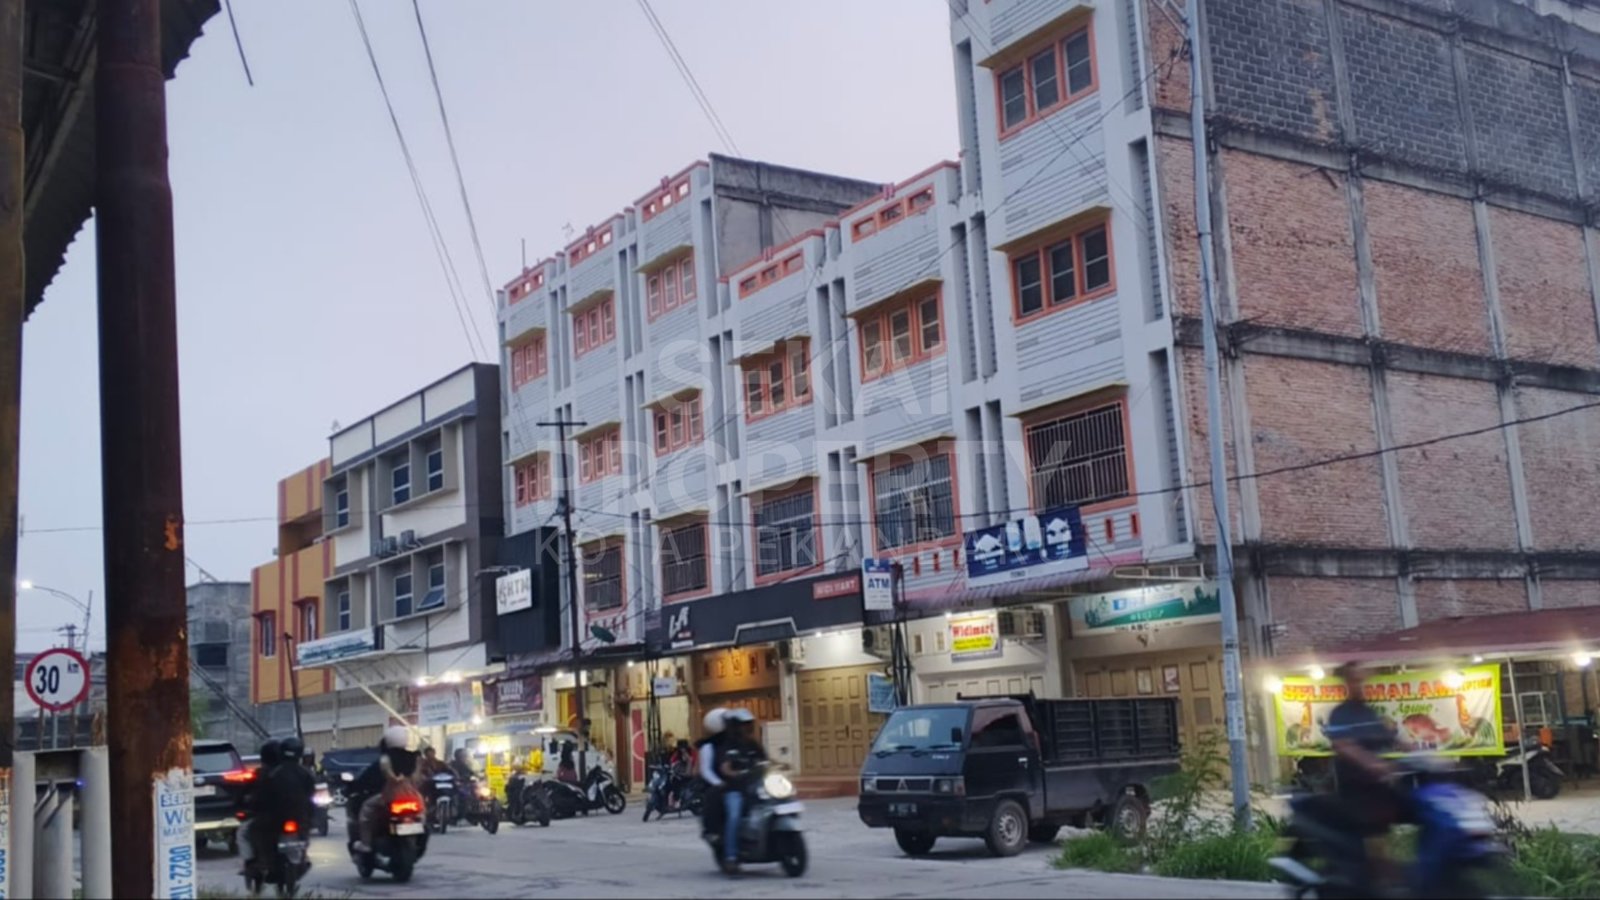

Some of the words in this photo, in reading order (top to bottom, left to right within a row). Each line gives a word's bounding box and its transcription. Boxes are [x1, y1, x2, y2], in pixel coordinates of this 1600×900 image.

[868, 577, 890, 589] ATM
[36, 665, 60, 694] 30
[164, 808, 192, 825] WC
